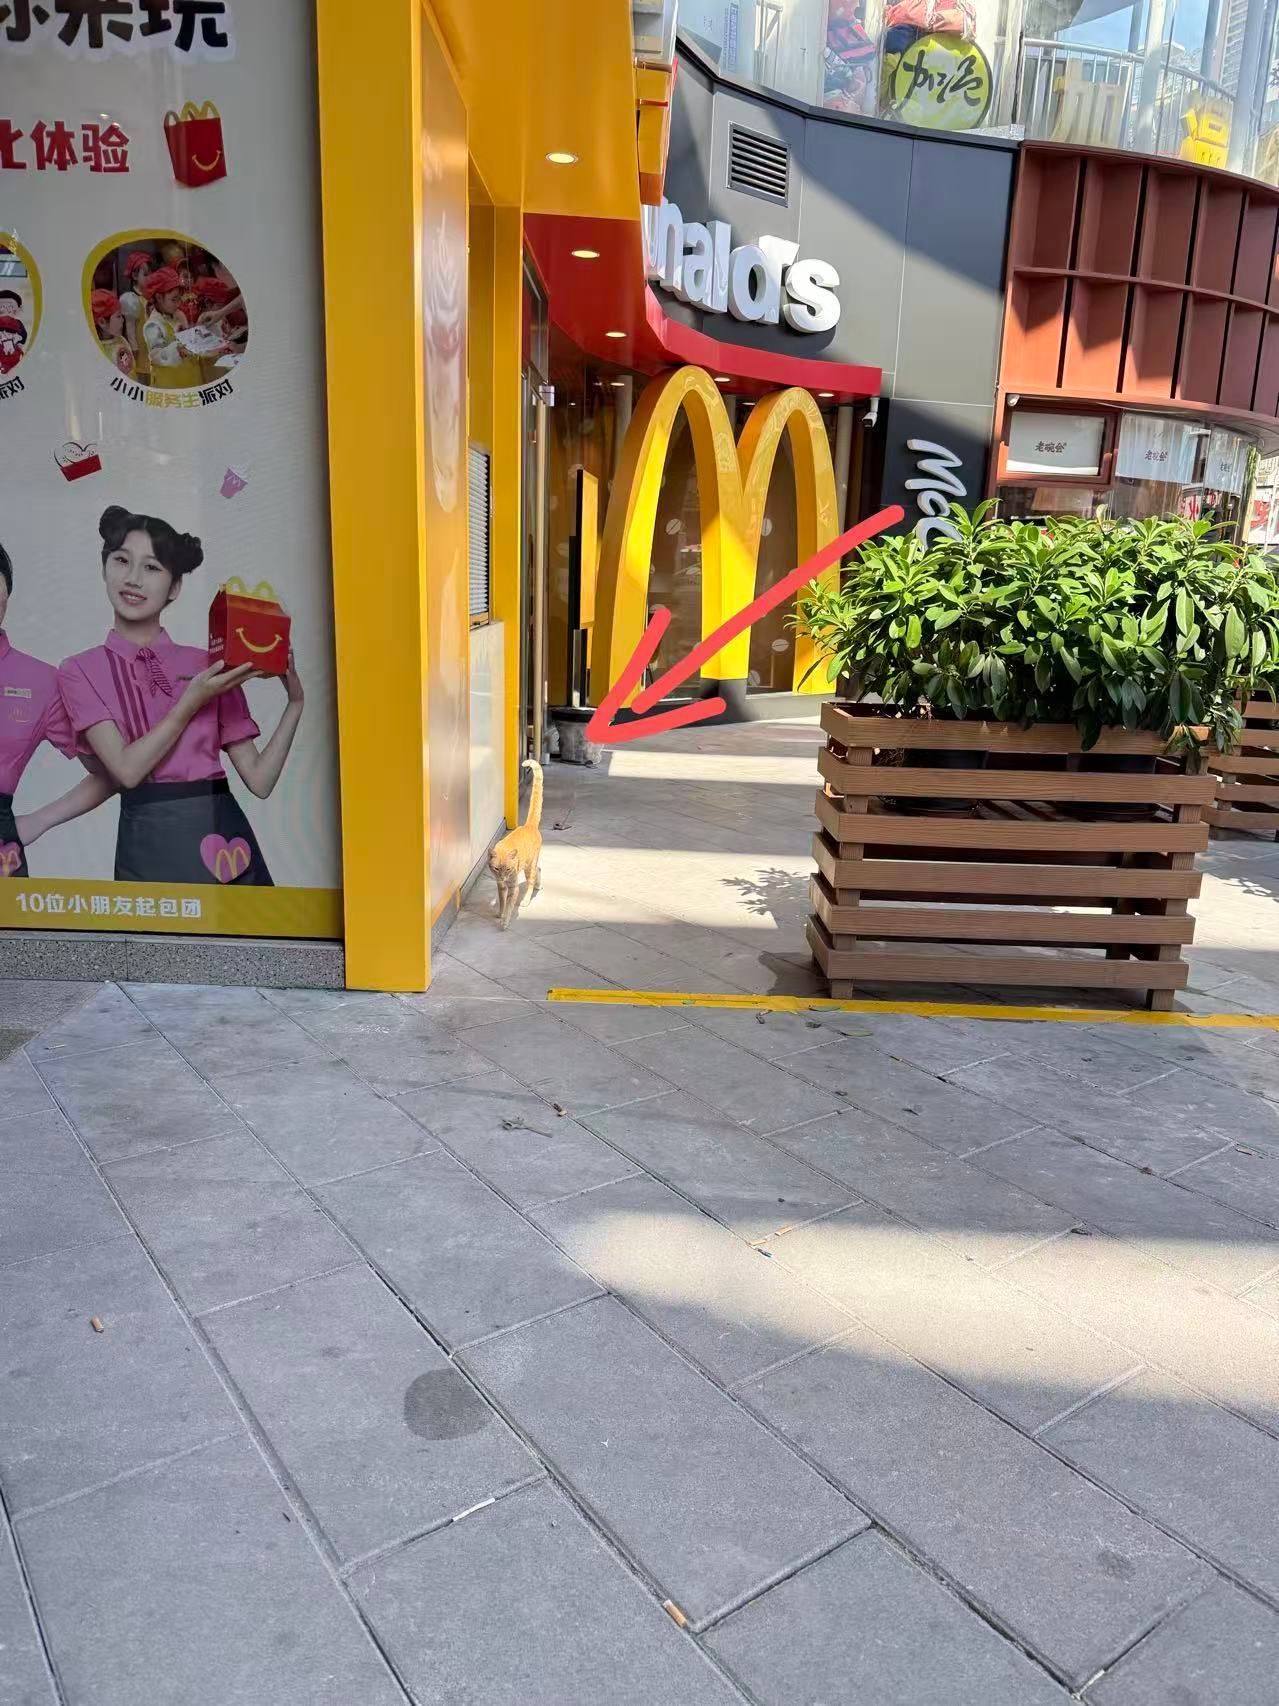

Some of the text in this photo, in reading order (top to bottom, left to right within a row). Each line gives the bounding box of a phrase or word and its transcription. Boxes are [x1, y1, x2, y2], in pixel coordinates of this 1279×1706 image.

[642, 196, 841, 334] nald's
[15, 892, 202, 918] 10位小朋友起包团
